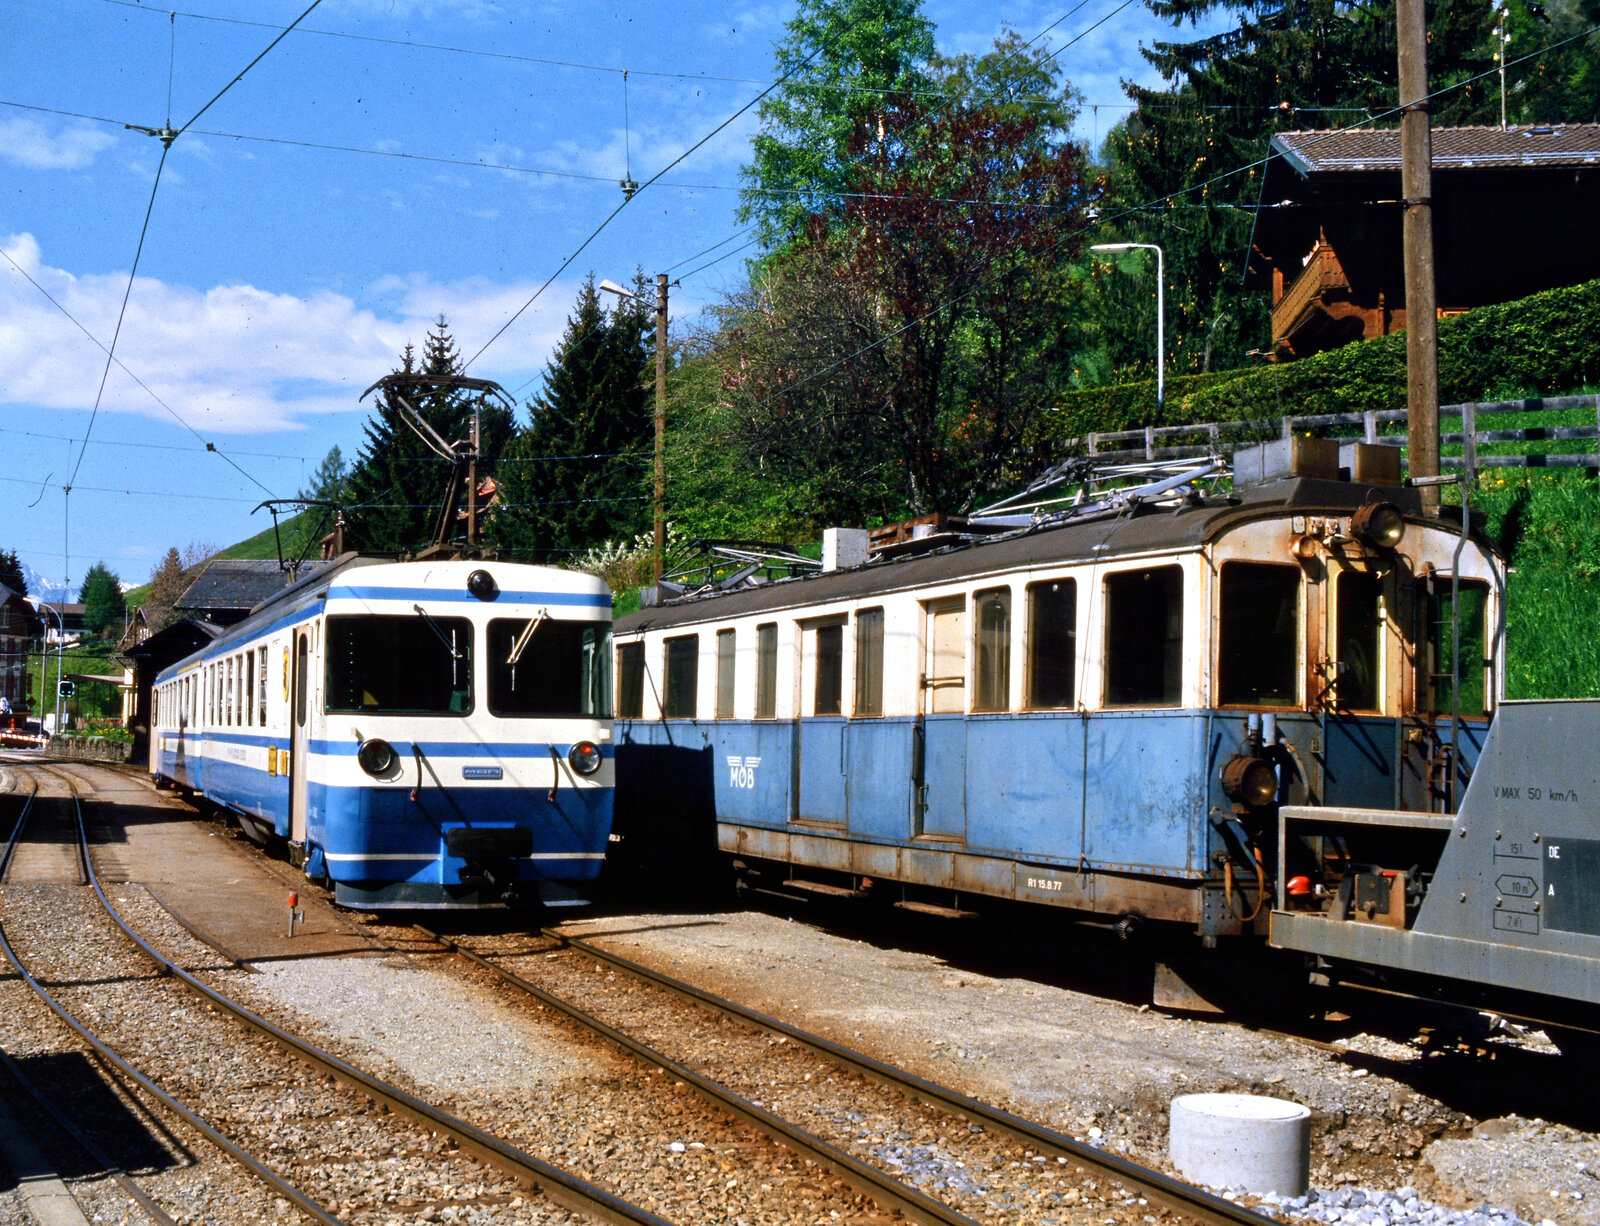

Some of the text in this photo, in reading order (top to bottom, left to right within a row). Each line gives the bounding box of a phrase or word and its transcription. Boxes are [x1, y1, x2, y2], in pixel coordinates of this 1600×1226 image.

[730, 766, 755, 789] MOB
[1528, 787, 1541, 800] 50
[1549, 788, 1578, 802] km/h
[1548, 845, 1560, 859] DE
[1548, 884, 1555, 896] A
